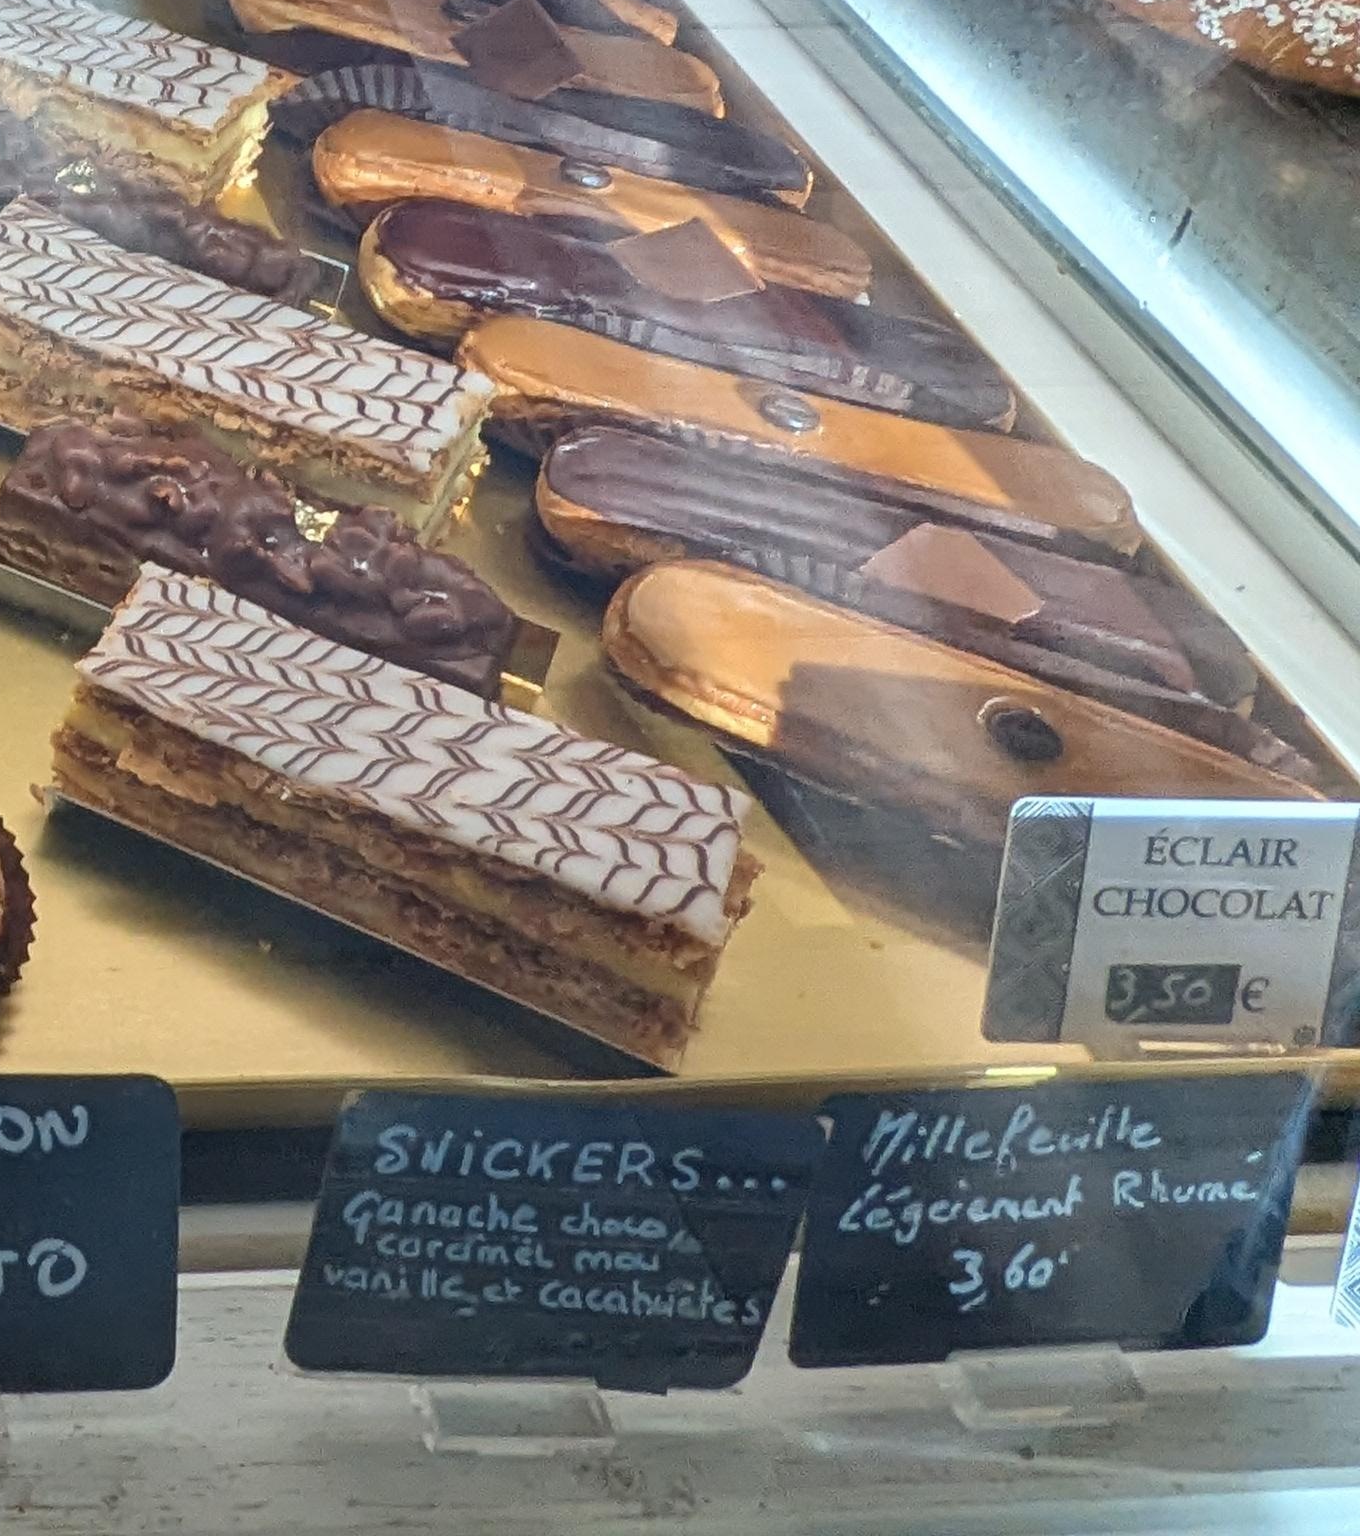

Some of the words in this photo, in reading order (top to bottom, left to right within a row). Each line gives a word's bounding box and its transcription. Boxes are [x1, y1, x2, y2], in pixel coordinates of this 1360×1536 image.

[1143, 829, 1298, 868] ÉCLAIR
[1092, 888, 1335, 923] CHOCOLAT
[341, 1189, 539, 1245] Ganache
[573, 1248, 660, 1273] mou
